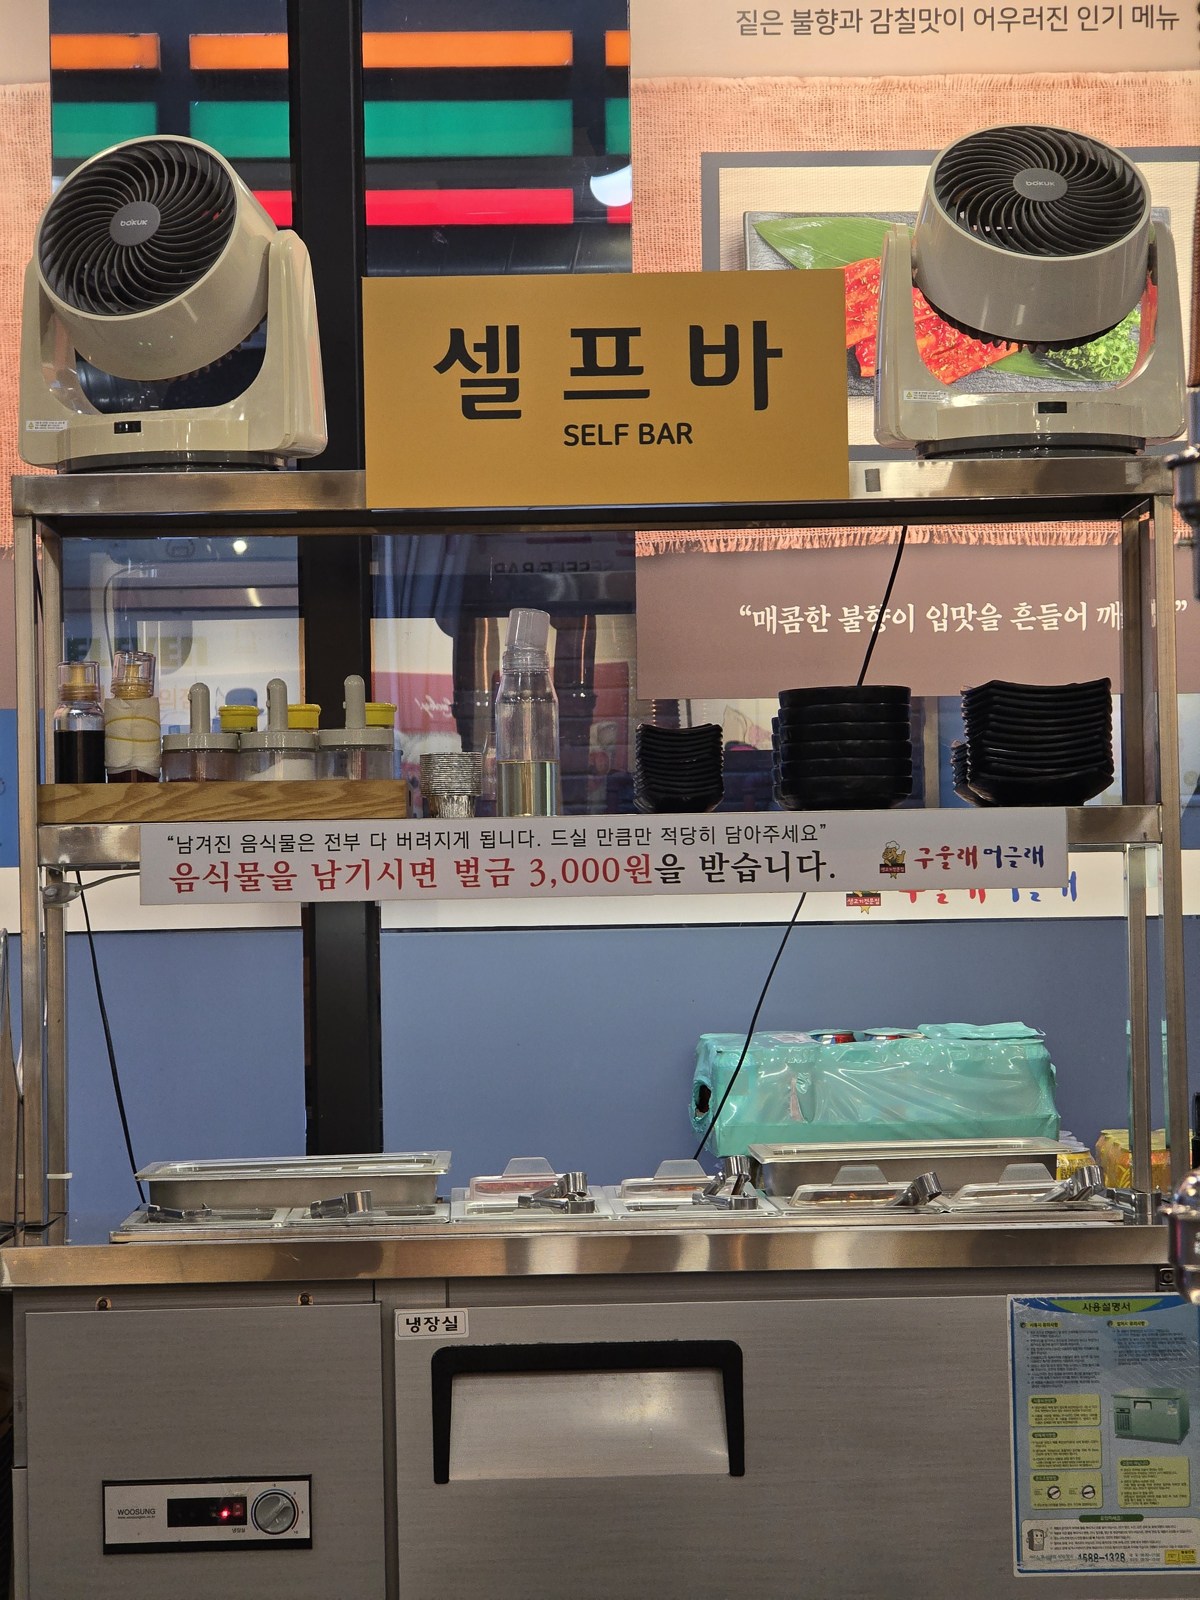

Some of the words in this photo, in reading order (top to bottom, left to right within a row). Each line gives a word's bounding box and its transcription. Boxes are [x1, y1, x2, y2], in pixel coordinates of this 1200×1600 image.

[735, 9, 784, 36] 짙은
[790, 8, 863, 36] 불향과
[869, 7, 966, 35] 감칠맛이
[972, 6, 1069, 34] 어우러진
[1076, 5, 1124, 31] 인기
[1131, 5, 1180, 31] 메뉴
[563, 423, 630, 447] SELF
[638, 422, 694, 446] BAR
[739, 604, 832, 635] “매콤한
[838, 603, 915, 634] 불향이
[926, 602, 1003, 633] 입맛을
[1009, 601, 1088, 632] 흔들어
[167, 834, 231, 855] “남겨진
[240, 833, 316, 854] 음식물은
[324, 832, 361, 853] 전부
[370, 832, 387, 852] 다
[396, 830, 470, 851] 버려지게
[479, 828, 541, 849] 됩니다.
[551, 828, 587, 848] 드실
[596, 827, 652, 847] 만큼만
[660, 825, 715, 846] 적당히
[724, 823, 827, 845] 담아주세요”
[913, 845, 979, 870] 구울래
[983, 844, 1044, 869] 머글래
[168, 860, 298, 894] 음식물을
[311, 857, 438, 892] 남기시면
[453, 856, 516, 888] 벌금
[529, 852, 686, 889] 3,000원을
[698, 850, 836, 883] 받습니다.
[1082, 1302, 1131, 1312] 사용설명서
[405, 1315, 458, 1334] 냉장실
[117, 1508, 156, 1516] WOOSUNG
